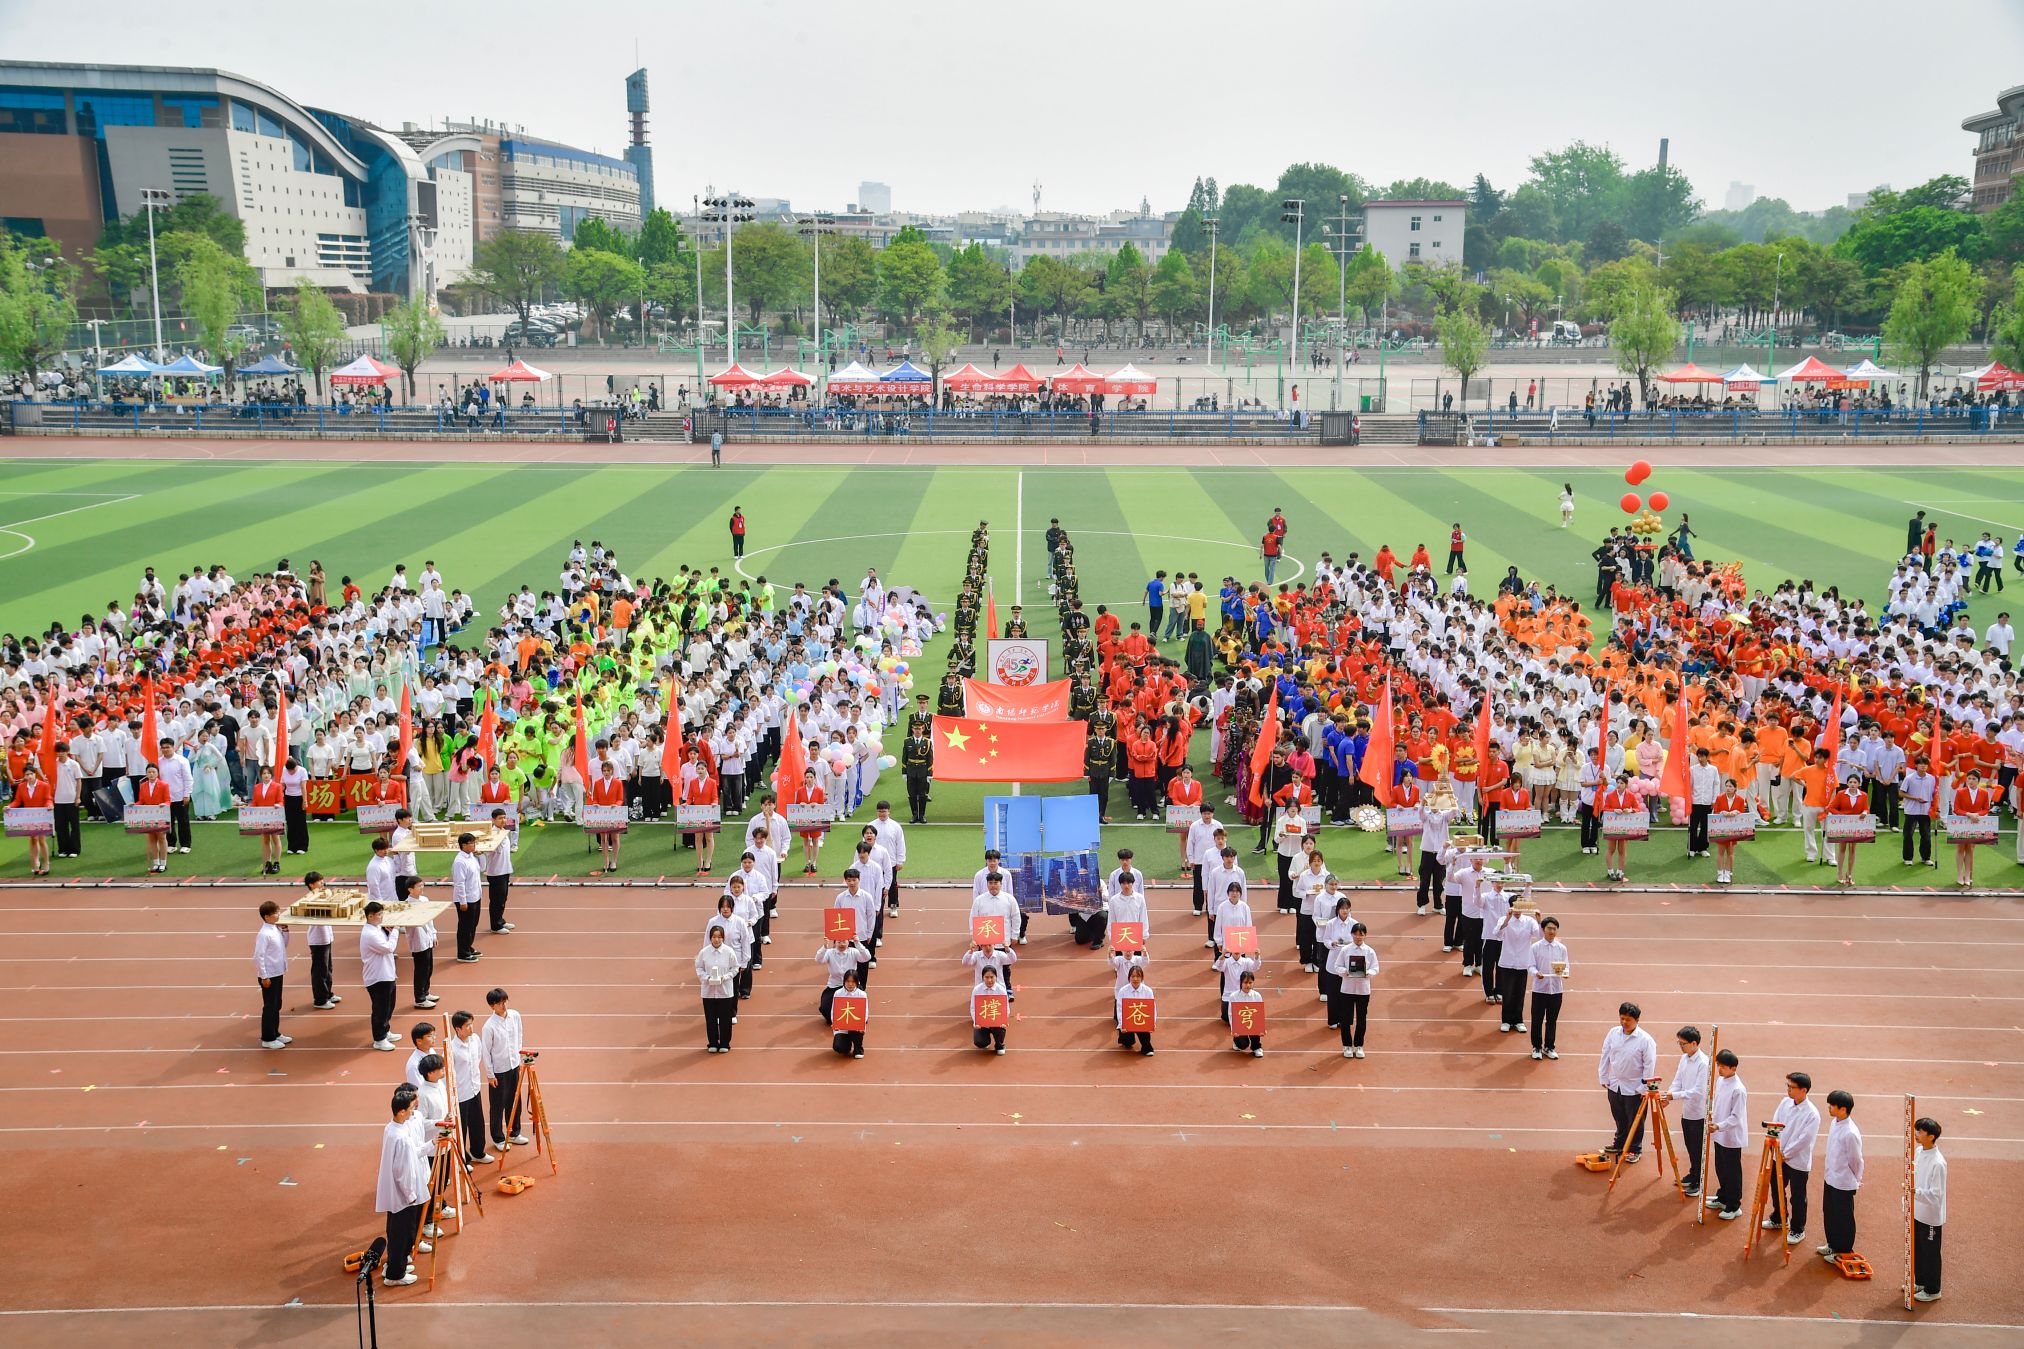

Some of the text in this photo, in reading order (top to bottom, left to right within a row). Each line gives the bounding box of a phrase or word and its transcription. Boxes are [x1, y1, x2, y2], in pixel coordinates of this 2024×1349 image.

[830, 384, 931, 393] 美术与艺术设计学院
[960, 383, 1030, 392] 生命科学学院
[309, 783, 335, 810] 场
[350, 779, 373, 802] 化
[830, 913, 1250, 948] 土 承 天 下
[837, 999, 1258, 1030] 木 撑 苍 穹
